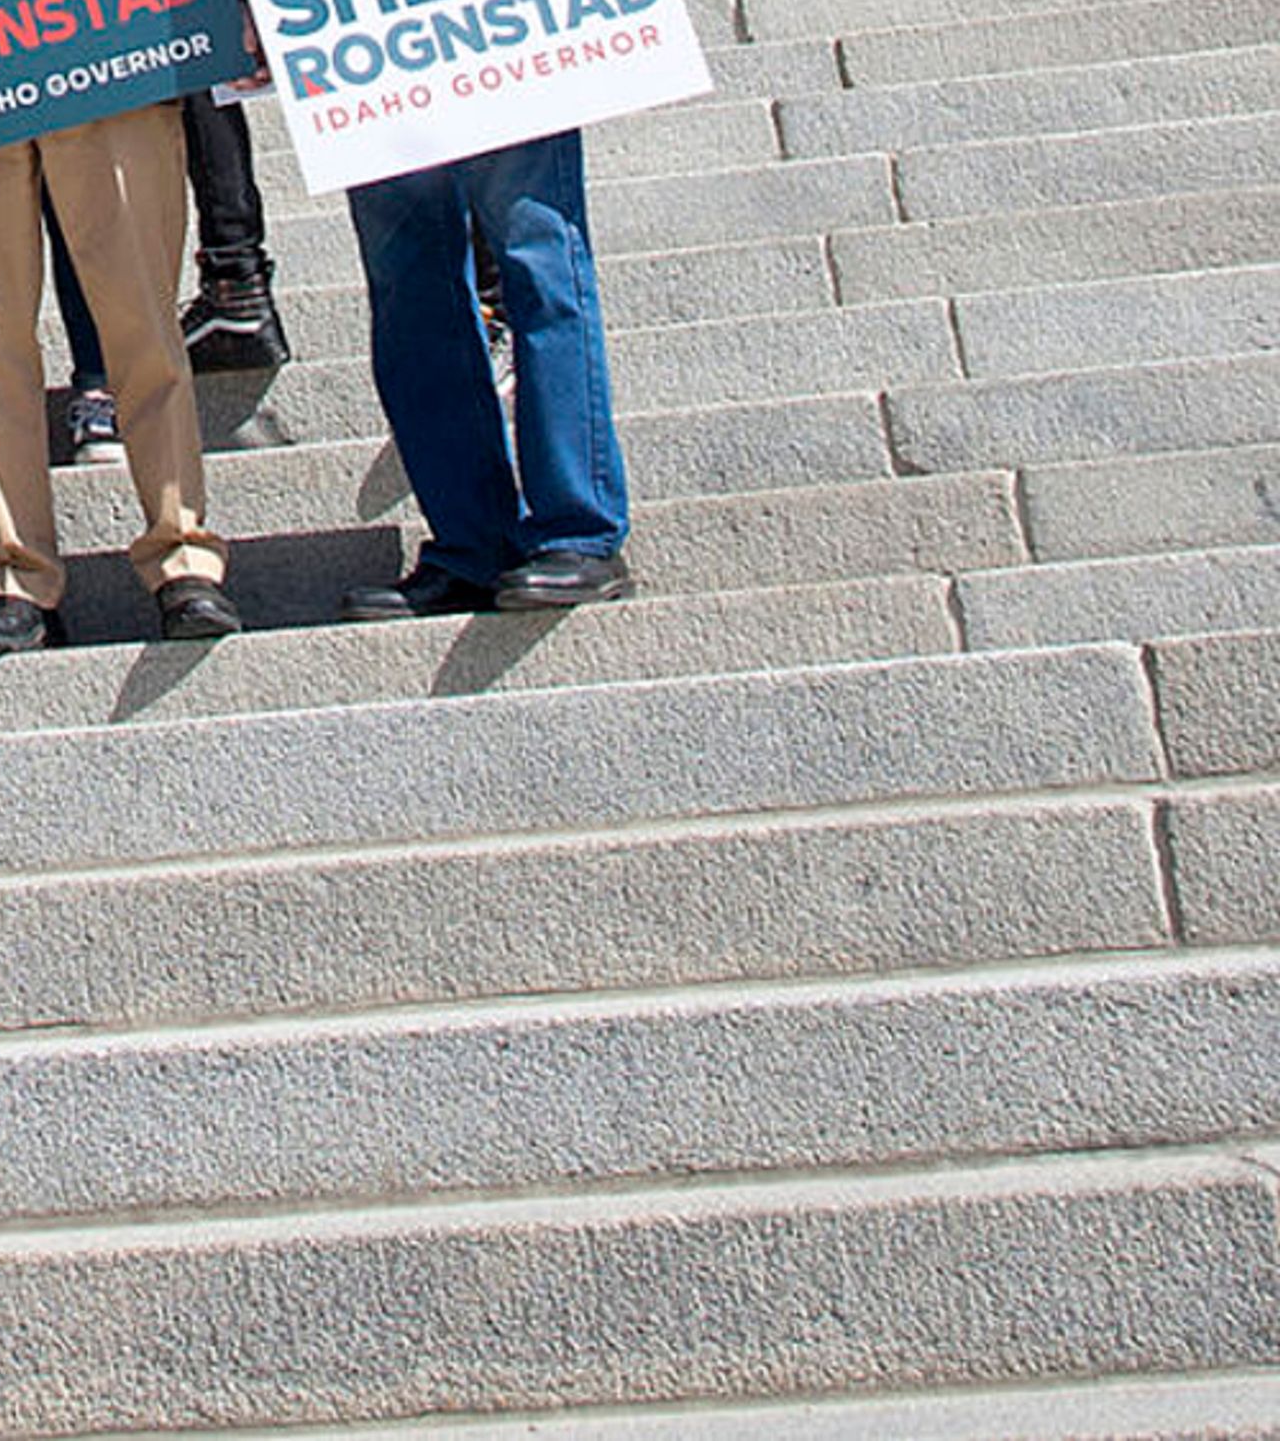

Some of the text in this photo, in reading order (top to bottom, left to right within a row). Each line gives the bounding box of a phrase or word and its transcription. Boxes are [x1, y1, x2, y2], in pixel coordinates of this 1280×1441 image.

[46, 33, 212, 97] GOVERNOR
[313, 25, 662, 133] IDAHO GOVERNOR
